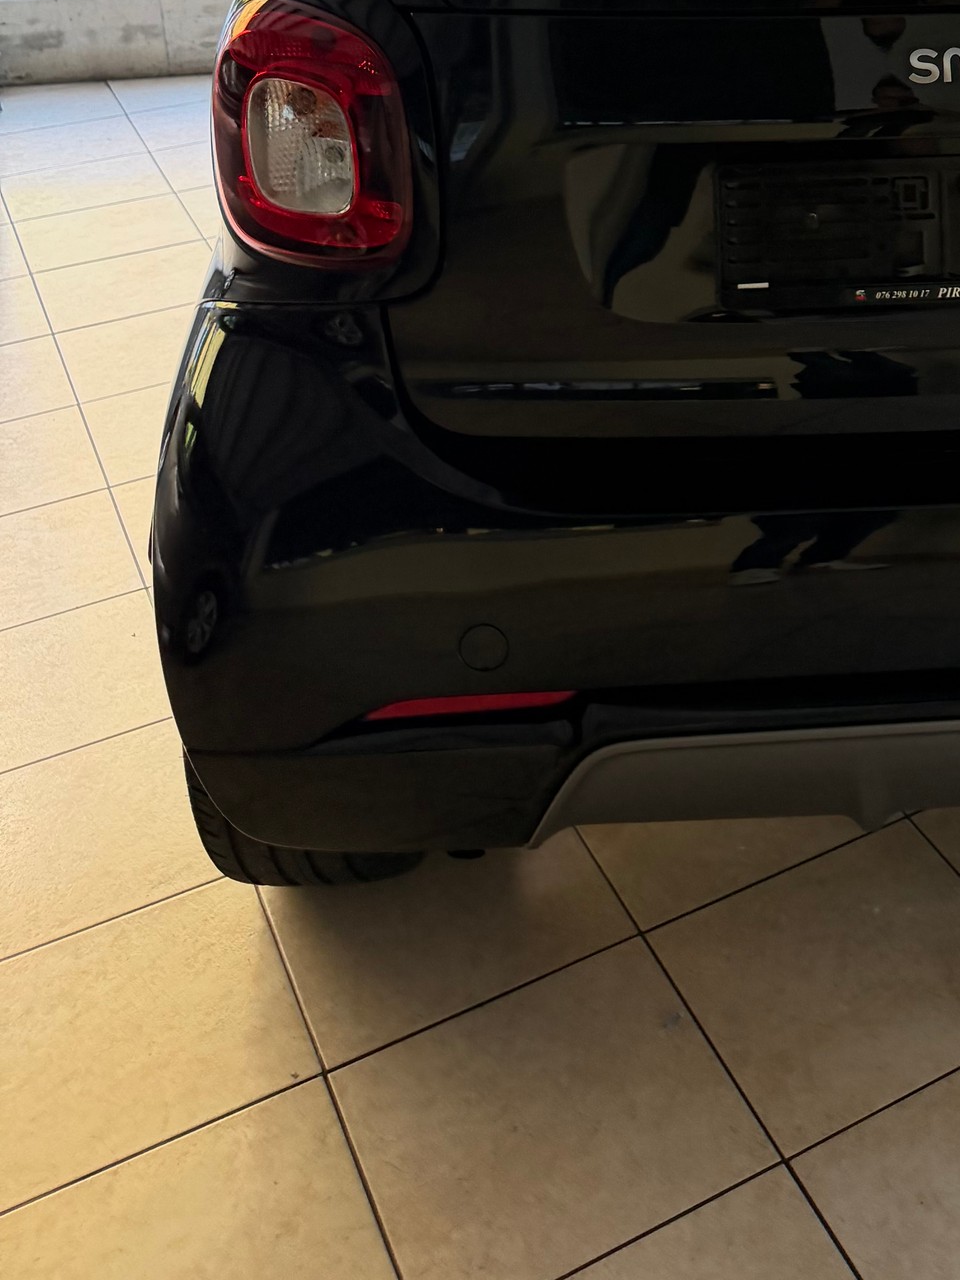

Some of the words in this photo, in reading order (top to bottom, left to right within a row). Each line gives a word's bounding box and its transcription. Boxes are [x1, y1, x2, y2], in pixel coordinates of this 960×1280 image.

[875, 291, 891, 299] 076
[891, 290, 907, 299] 298
[908, 290, 919, 298] 10
[920, 289, 930, 298] 17
